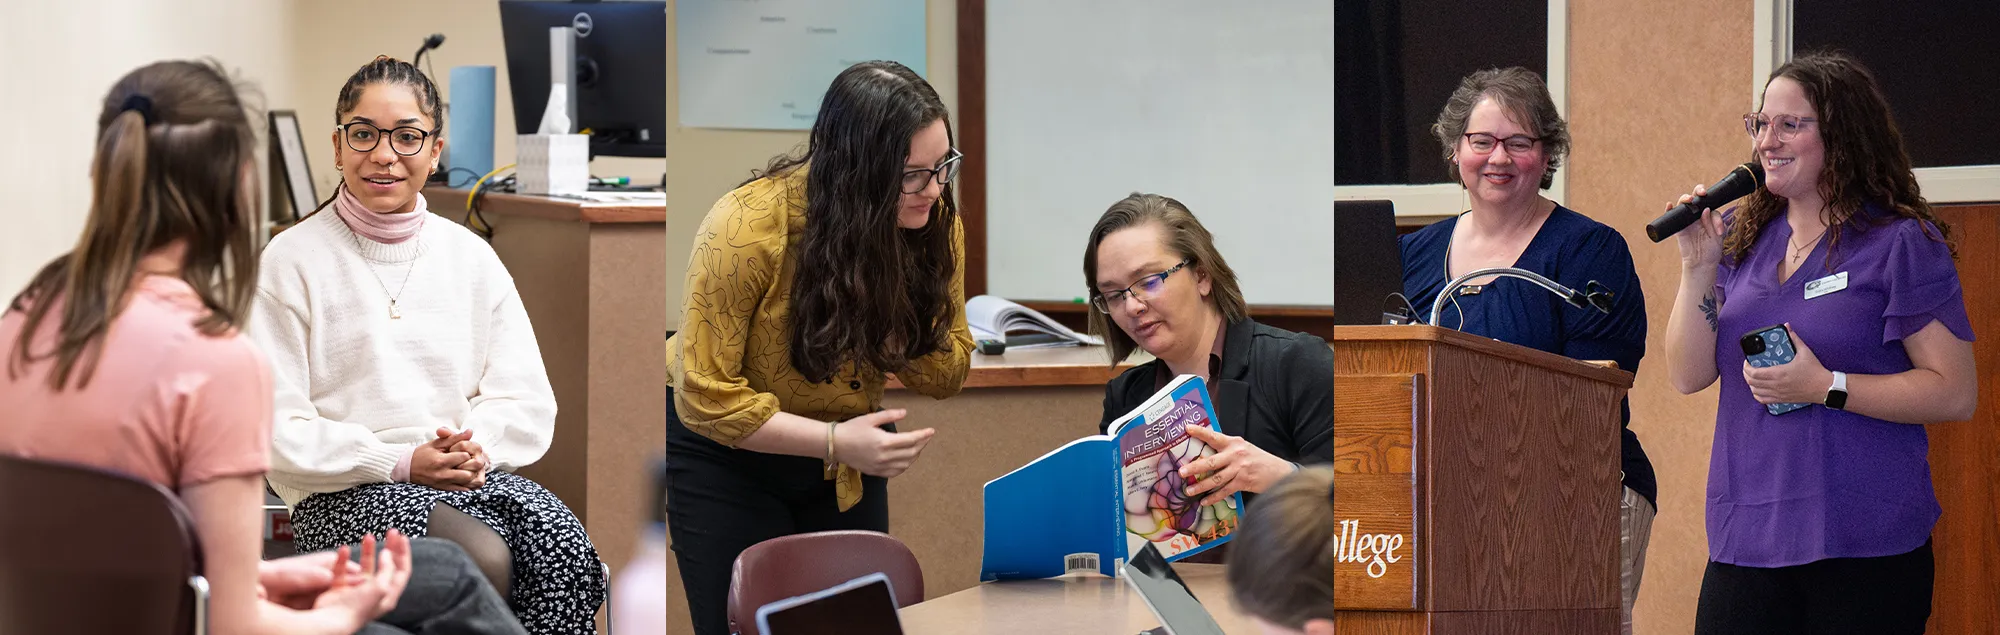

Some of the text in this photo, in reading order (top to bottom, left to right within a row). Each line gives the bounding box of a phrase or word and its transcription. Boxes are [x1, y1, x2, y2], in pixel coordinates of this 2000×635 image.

[1145, 400, 1198, 438] ESSENTIAL
[1124, 410, 1201, 460] INTERVIEWING
[1133, 451, 1157, 463] Programmed
[1156, 444, 1173, 454] Approach
[1170, 533, 1201, 555] SW
